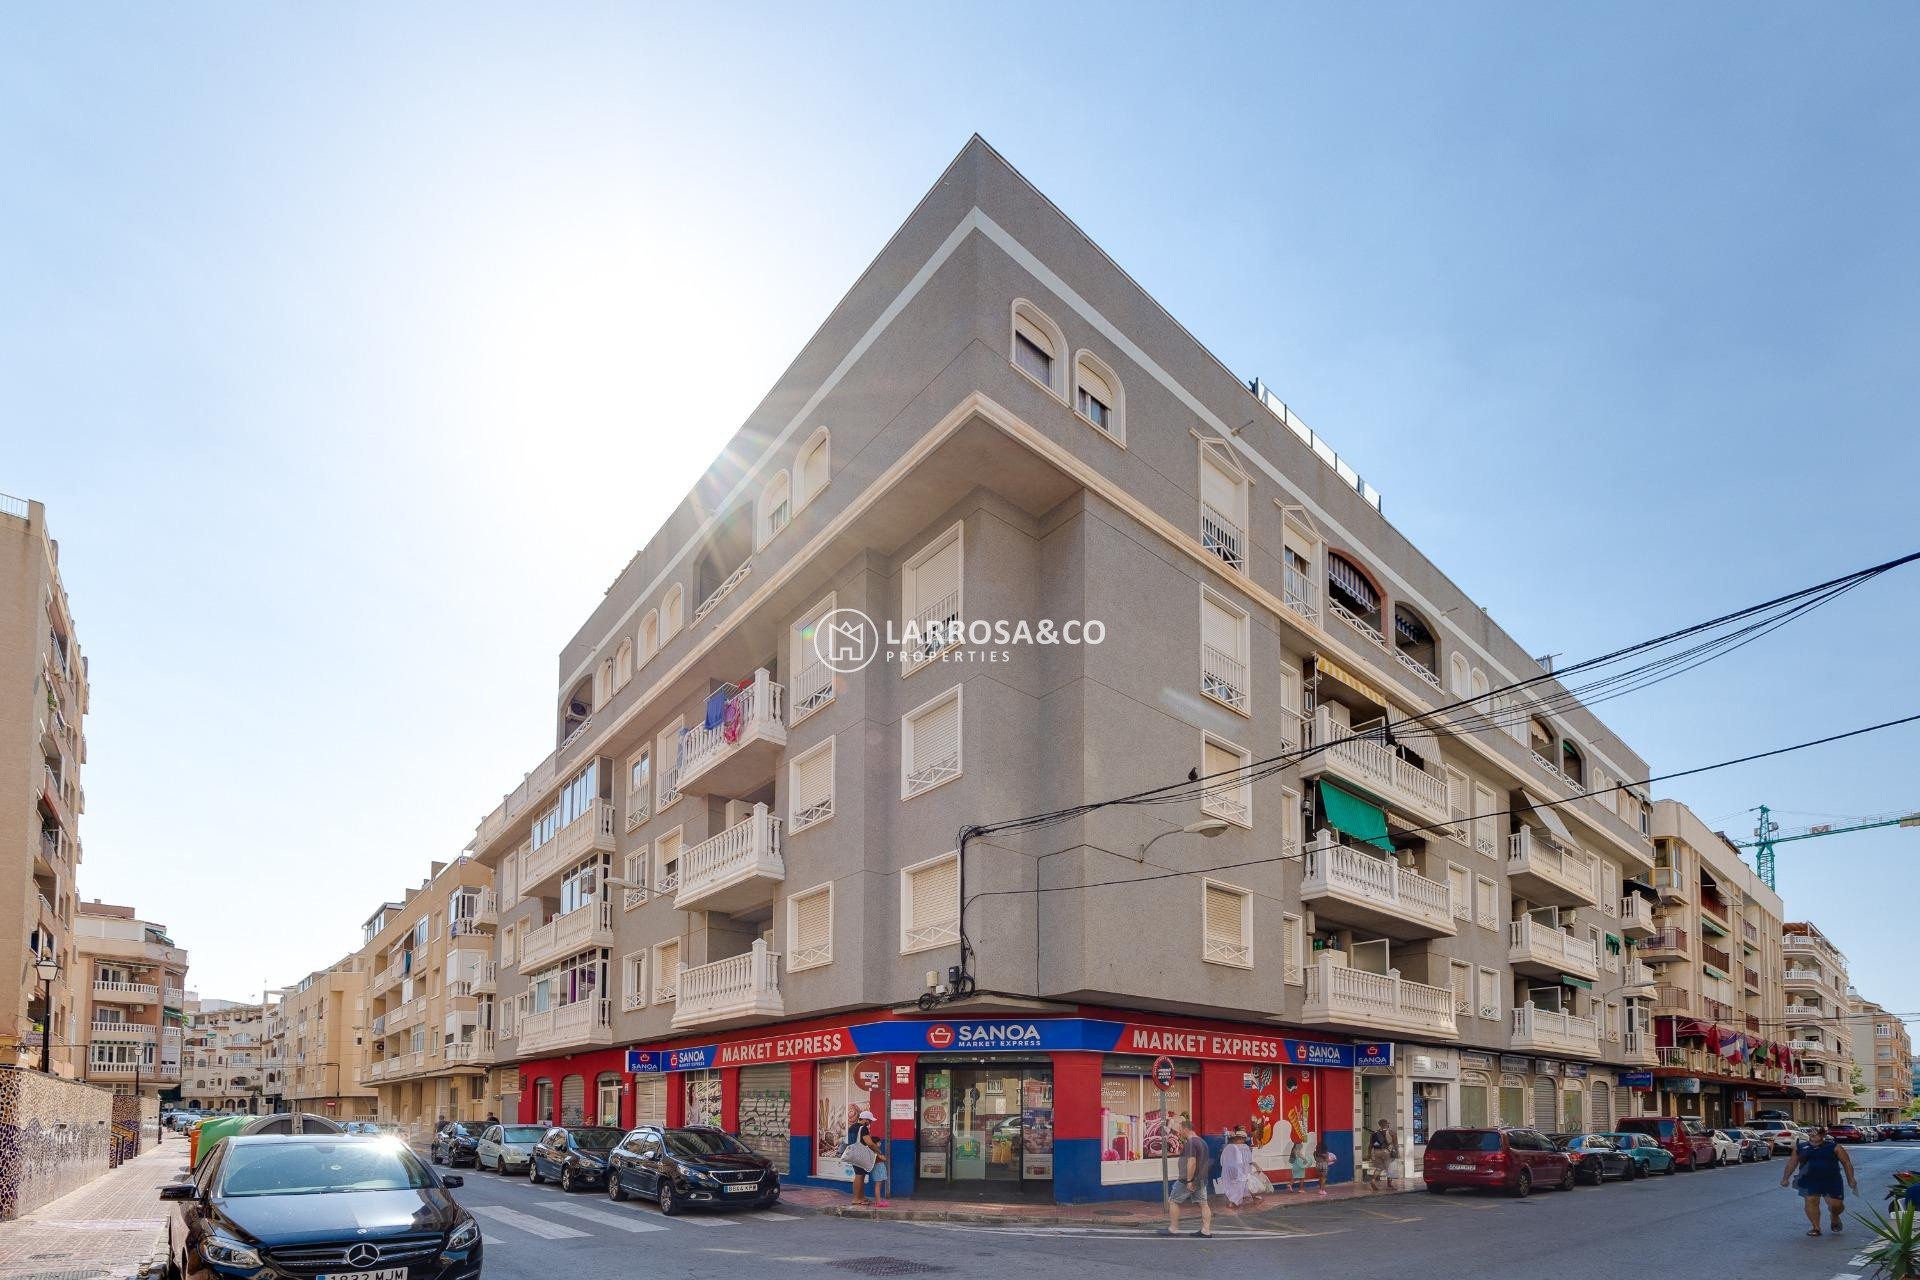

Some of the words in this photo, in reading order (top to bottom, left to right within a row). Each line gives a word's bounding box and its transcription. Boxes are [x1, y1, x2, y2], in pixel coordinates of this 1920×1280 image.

[958, 1024, 1041, 1041] SANOA
[722, 1042, 772, 1063] MARKET
[777, 1033, 842, 1057] EXPRESS
[1132, 1029, 1207, 1052] MARKET
[1212, 1037, 1278, 1058] EXPRESS
[678, 1050, 705, 1064] SANOA
[1308, 1045, 1341, 1060] SANOA
